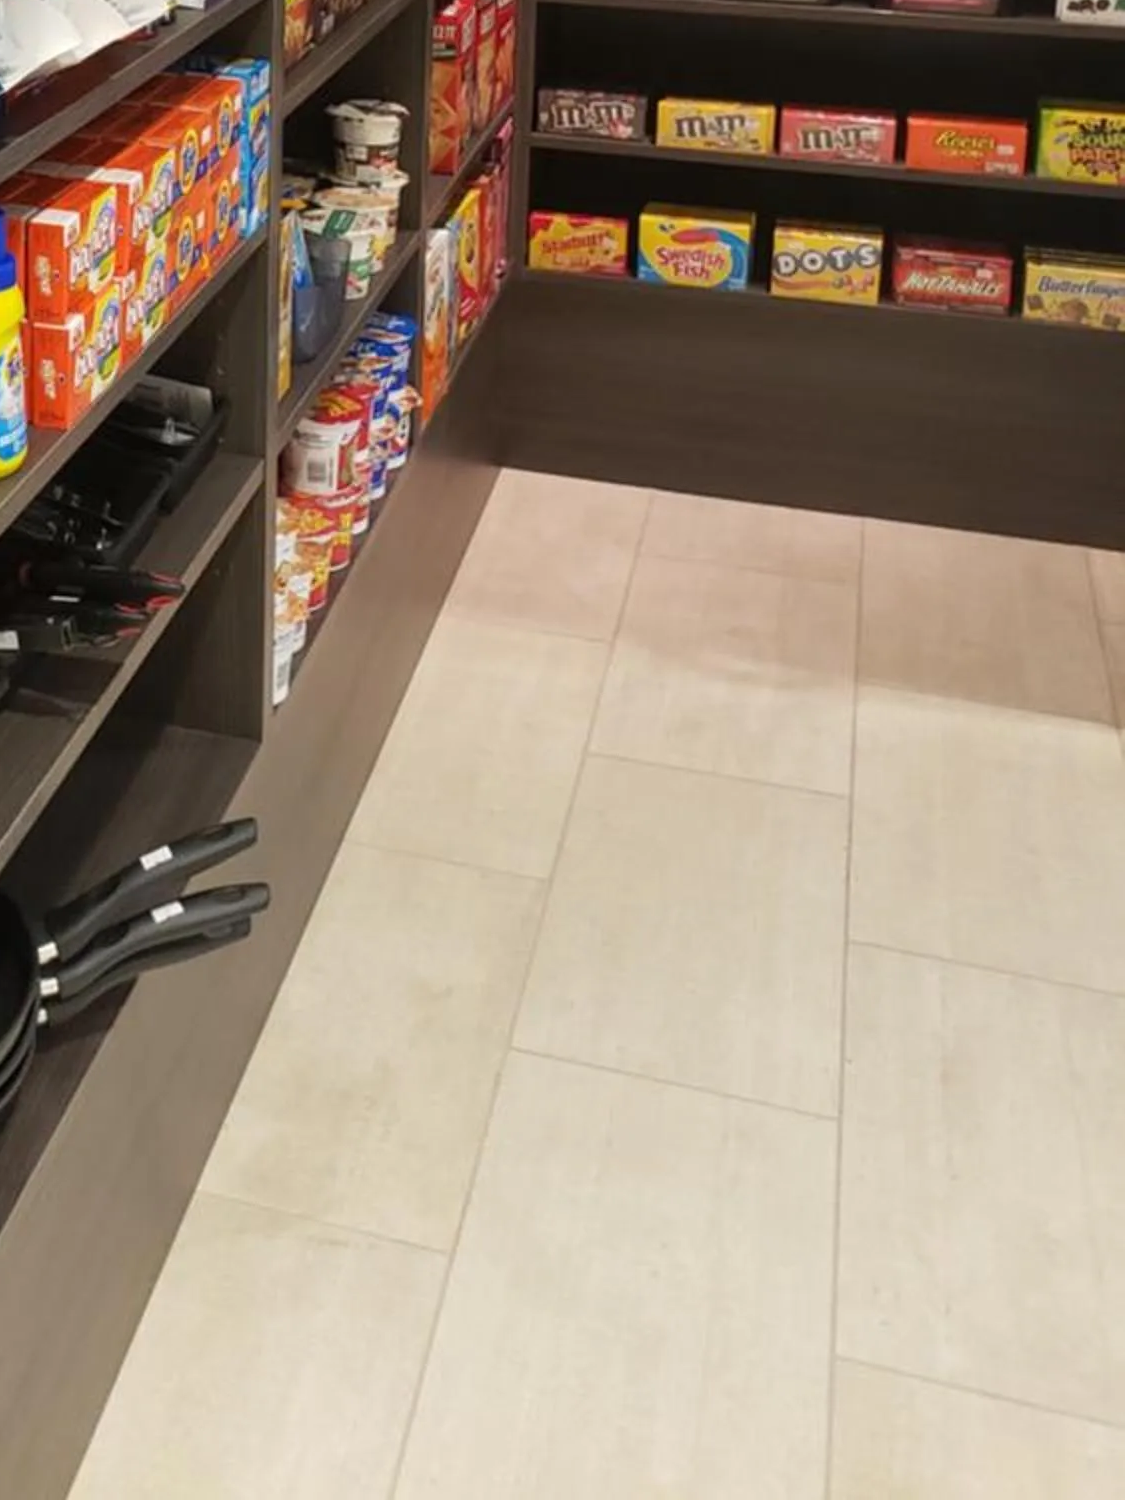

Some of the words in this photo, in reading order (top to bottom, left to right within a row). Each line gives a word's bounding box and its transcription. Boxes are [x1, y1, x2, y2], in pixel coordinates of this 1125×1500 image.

[655, 247, 726, 270] Swedish
[776, 244, 877, 276] DOTS
[673, 264, 712, 280] Fish
[1038, 276, 1125, 296] Butterfinge
